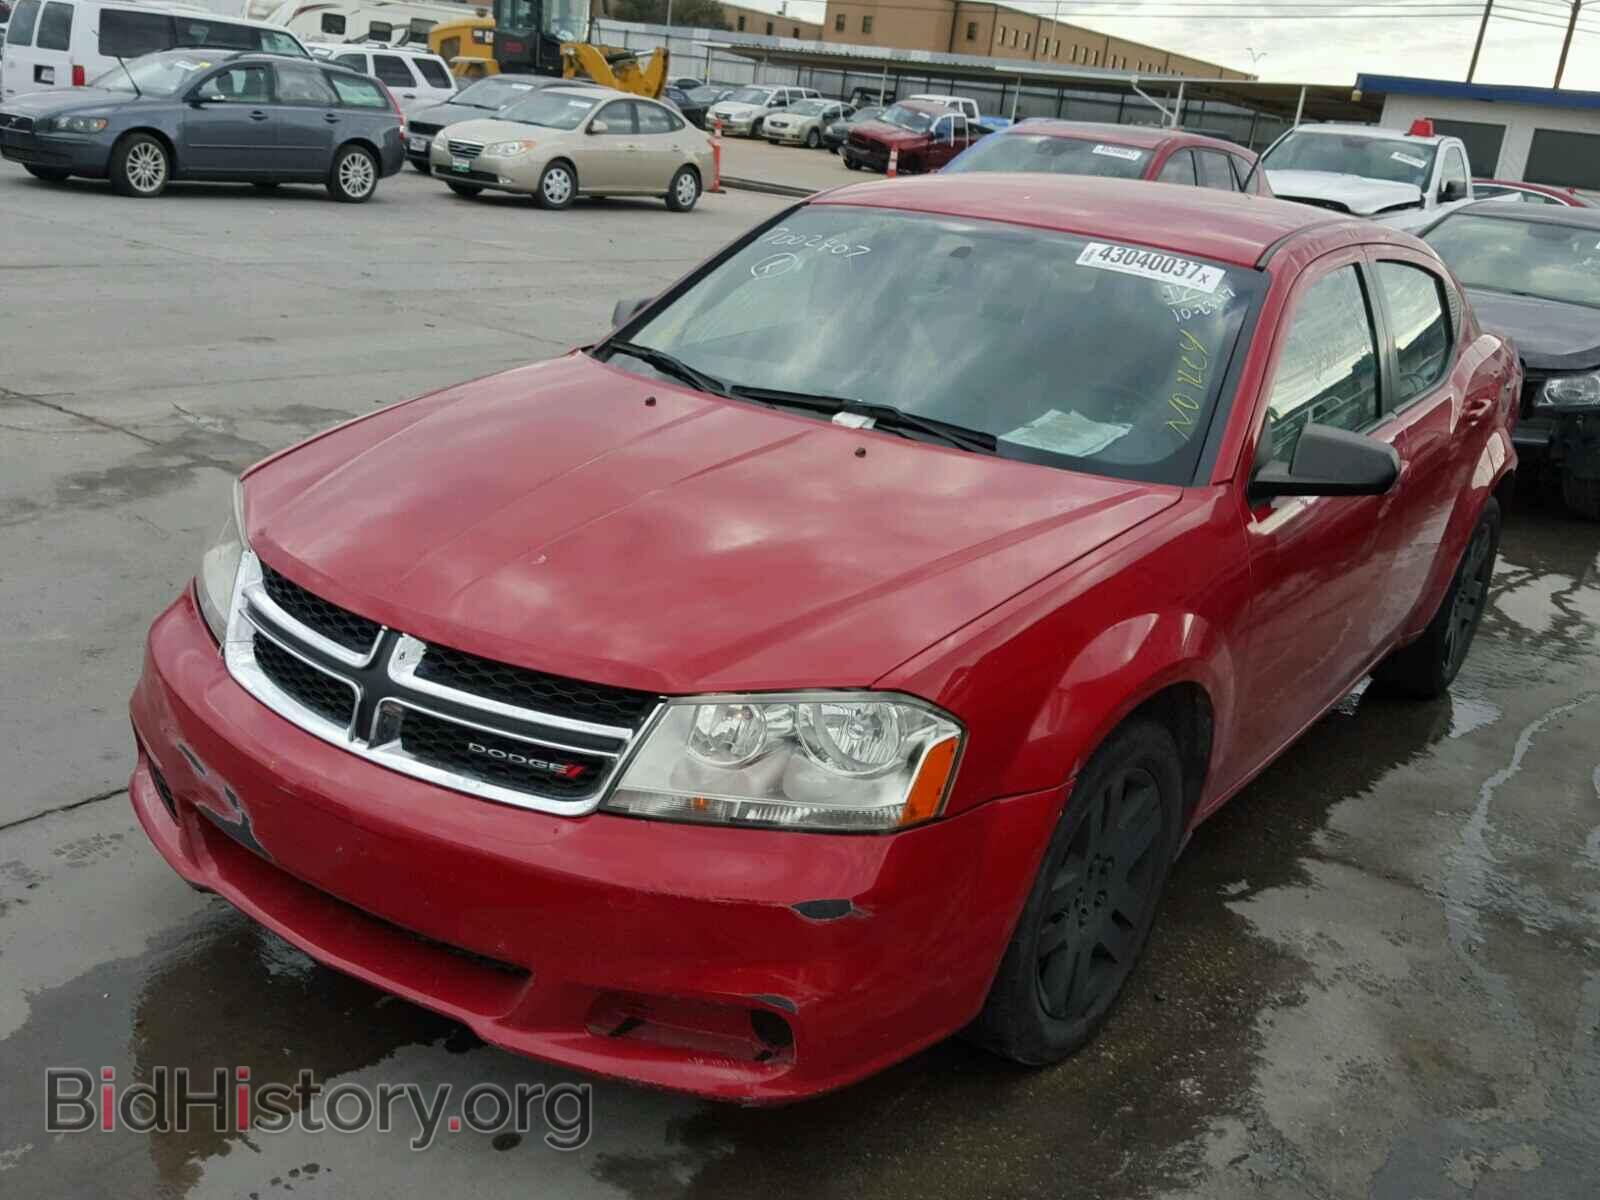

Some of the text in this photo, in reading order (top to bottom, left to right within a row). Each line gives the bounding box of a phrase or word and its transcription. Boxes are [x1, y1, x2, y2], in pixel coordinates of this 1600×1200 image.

[1098, 246, 1203, 280] 43040037
[1165, 392, 1200, 441] NO
[467, 742, 568, 775] DODGE
